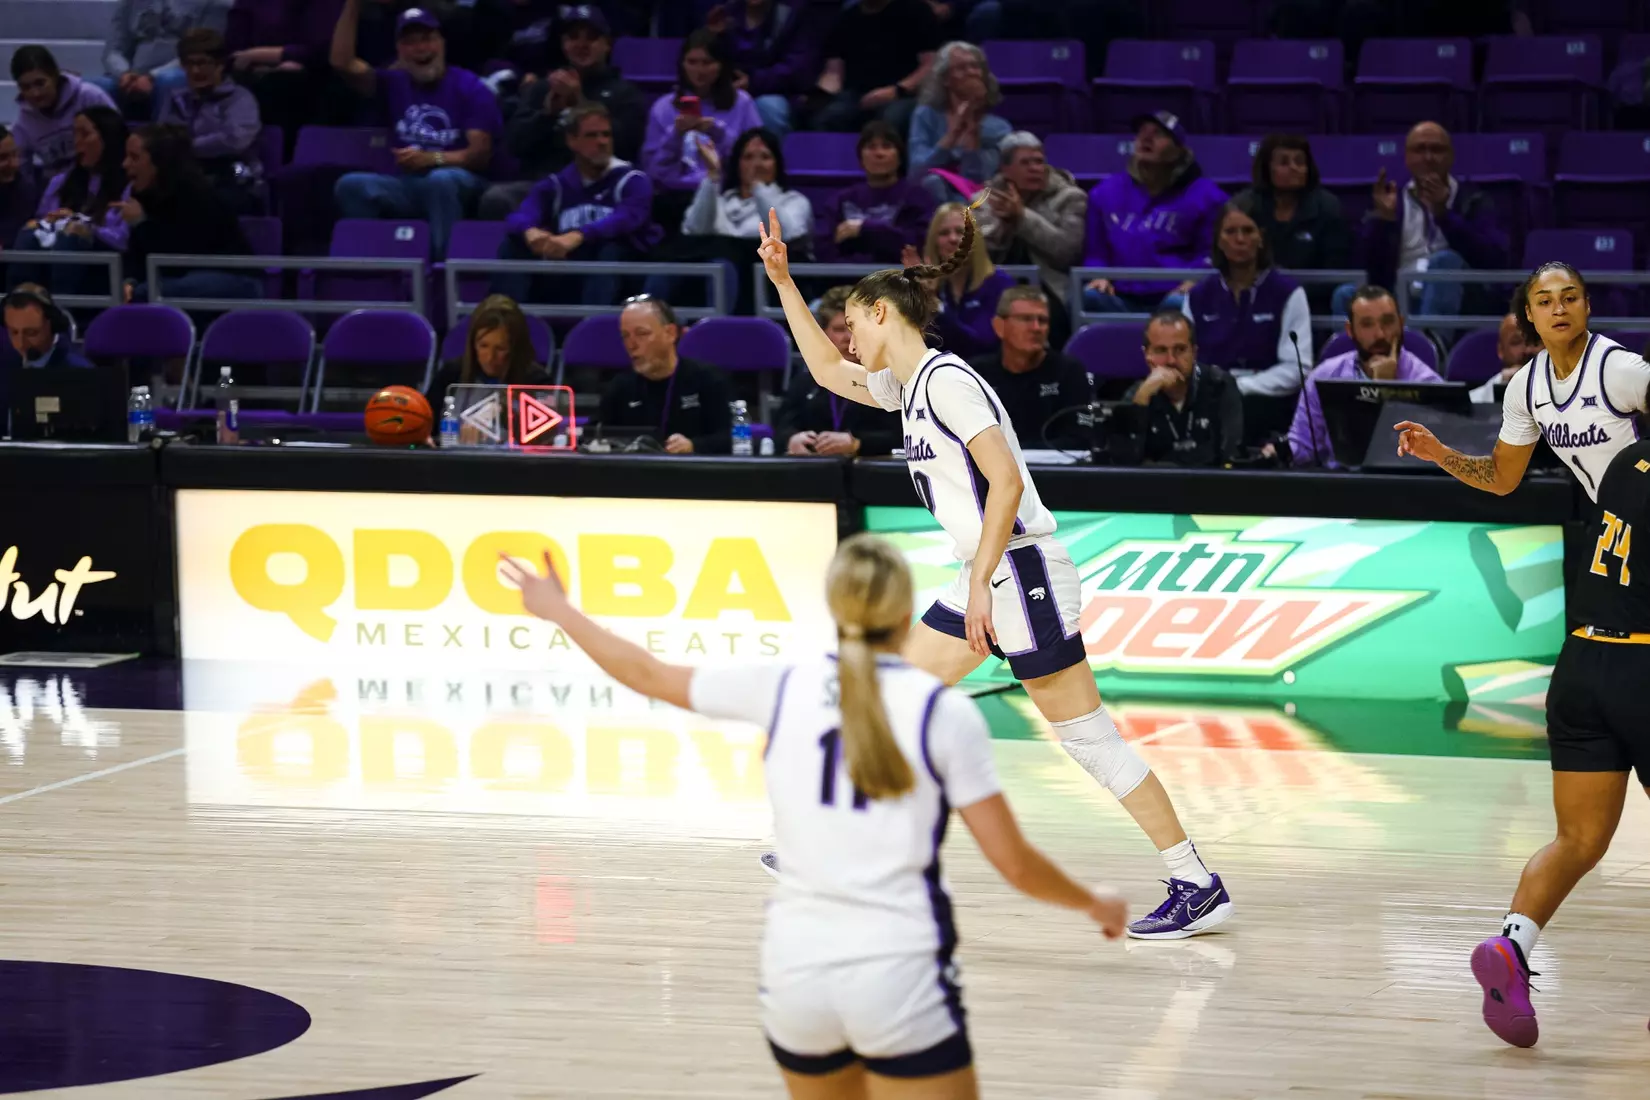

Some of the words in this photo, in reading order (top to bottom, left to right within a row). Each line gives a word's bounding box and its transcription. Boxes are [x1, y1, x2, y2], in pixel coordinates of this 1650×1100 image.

[1538, 421, 1612, 448] Wildcats
[1572, 454, 1596, 492] 1
[1590, 510, 1632, 586] 24
[229, 523, 793, 643] QDOBA
[356, 621, 612, 653] MEXICA
[647, 630, 781, 656] EATS
